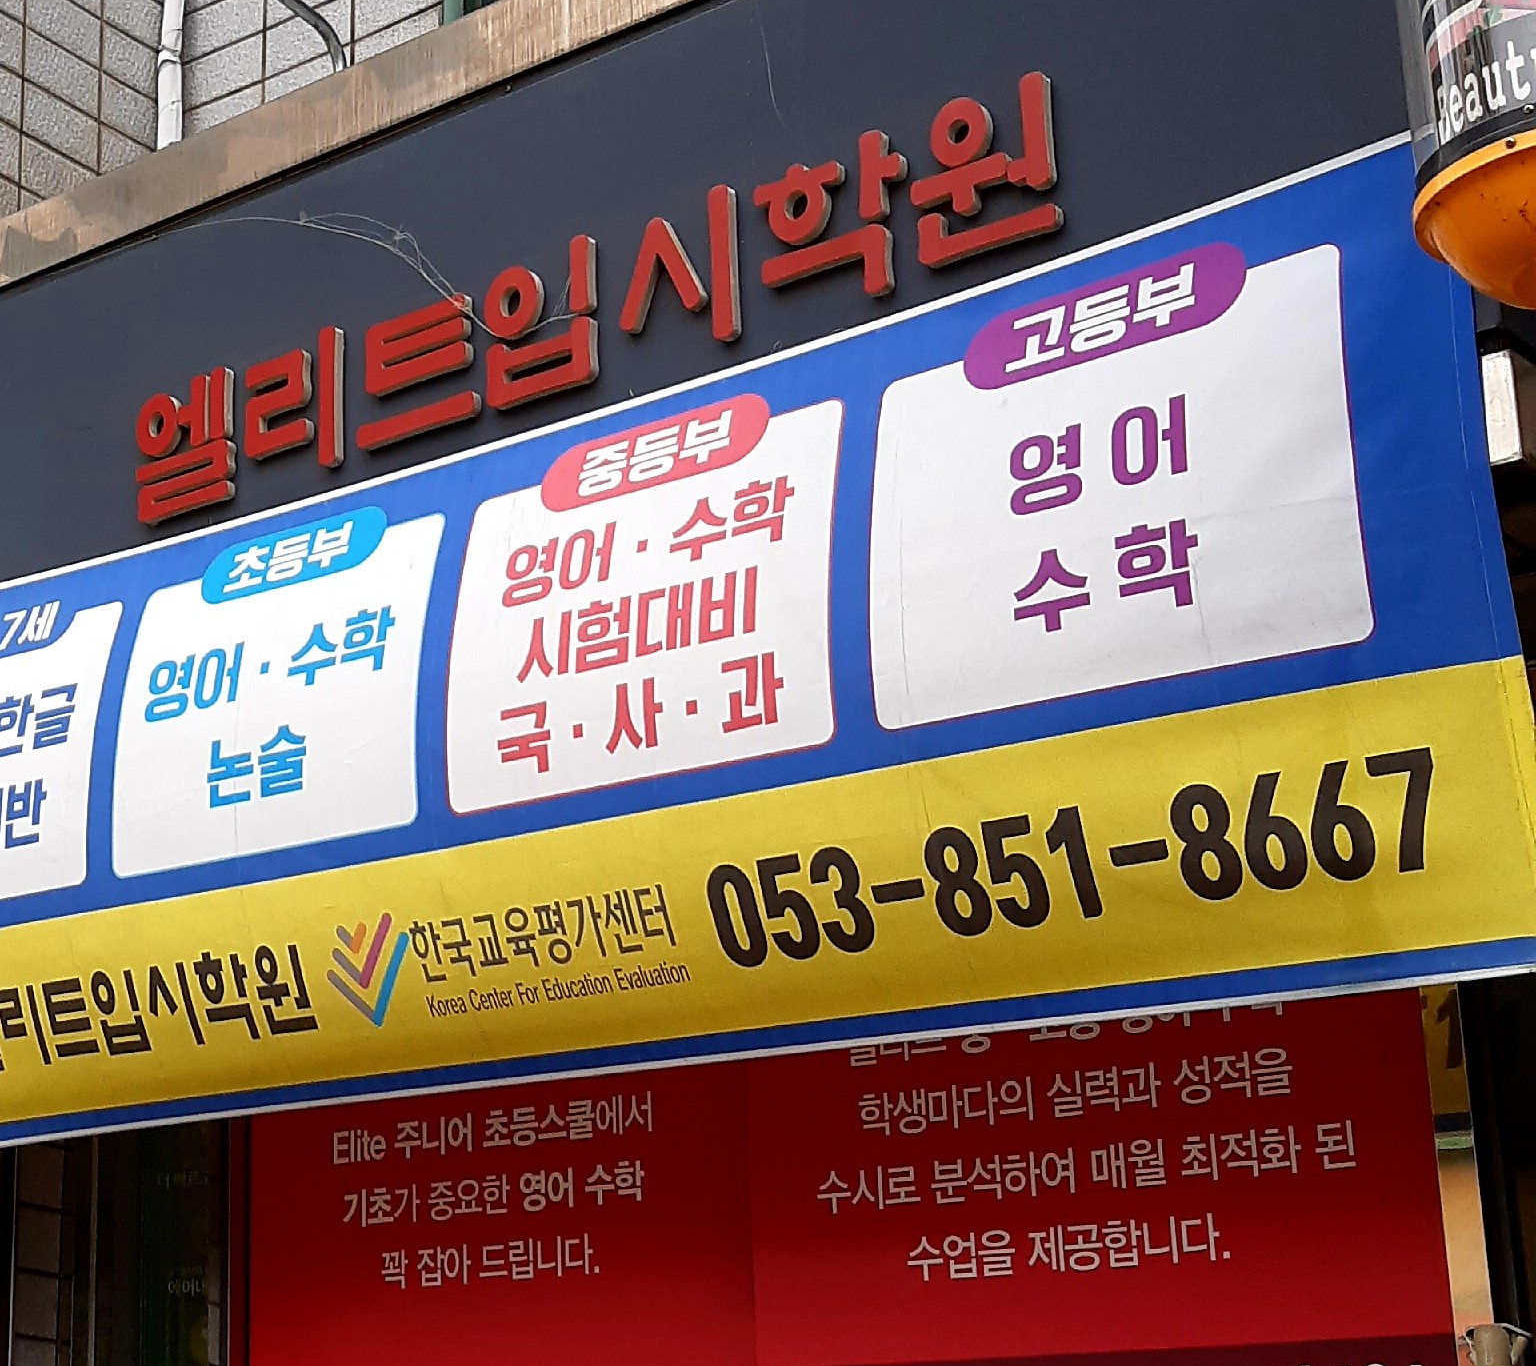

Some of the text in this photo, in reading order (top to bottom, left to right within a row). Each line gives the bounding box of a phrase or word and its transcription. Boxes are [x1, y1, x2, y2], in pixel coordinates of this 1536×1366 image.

[1436, 37, 1536, 141] Beaut
[135, 71, 1065, 525] 엘리트입시학원
[1005, 262, 1197, 374] 고등부
[577, 409, 731, 498] 중등부
[1009, 393, 1191, 516] 영어
[223, 517, 357, 595] 초등부
[1013, 518, 1198, 633] 수학
[516, 566, 758, 684] 시험대비
[206, 724, 308, 810] 논술
[408, 882, 679, 986] 한국교육평가센터
[706, 745, 1435, 970] 053-851-8667
[426, 959, 691, 1019] Korea Center For Education Evaluation
[332, 1090, 654, 1165] Elite 주니어 초등스쿨에서
[858, 1046, 1293, 1136] 학생마다의 실력과 성적을
[343, 1160, 644, 1228] 기초가 중요한 영어 수학
[817, 1119, 1356, 1214] 수시로 분석하여 매월 최적화 된
[381, 1233, 601, 1289] 꽉 잡아 드립니다.
[907, 1212, 1232, 1282] 수업을 제공합니다.
